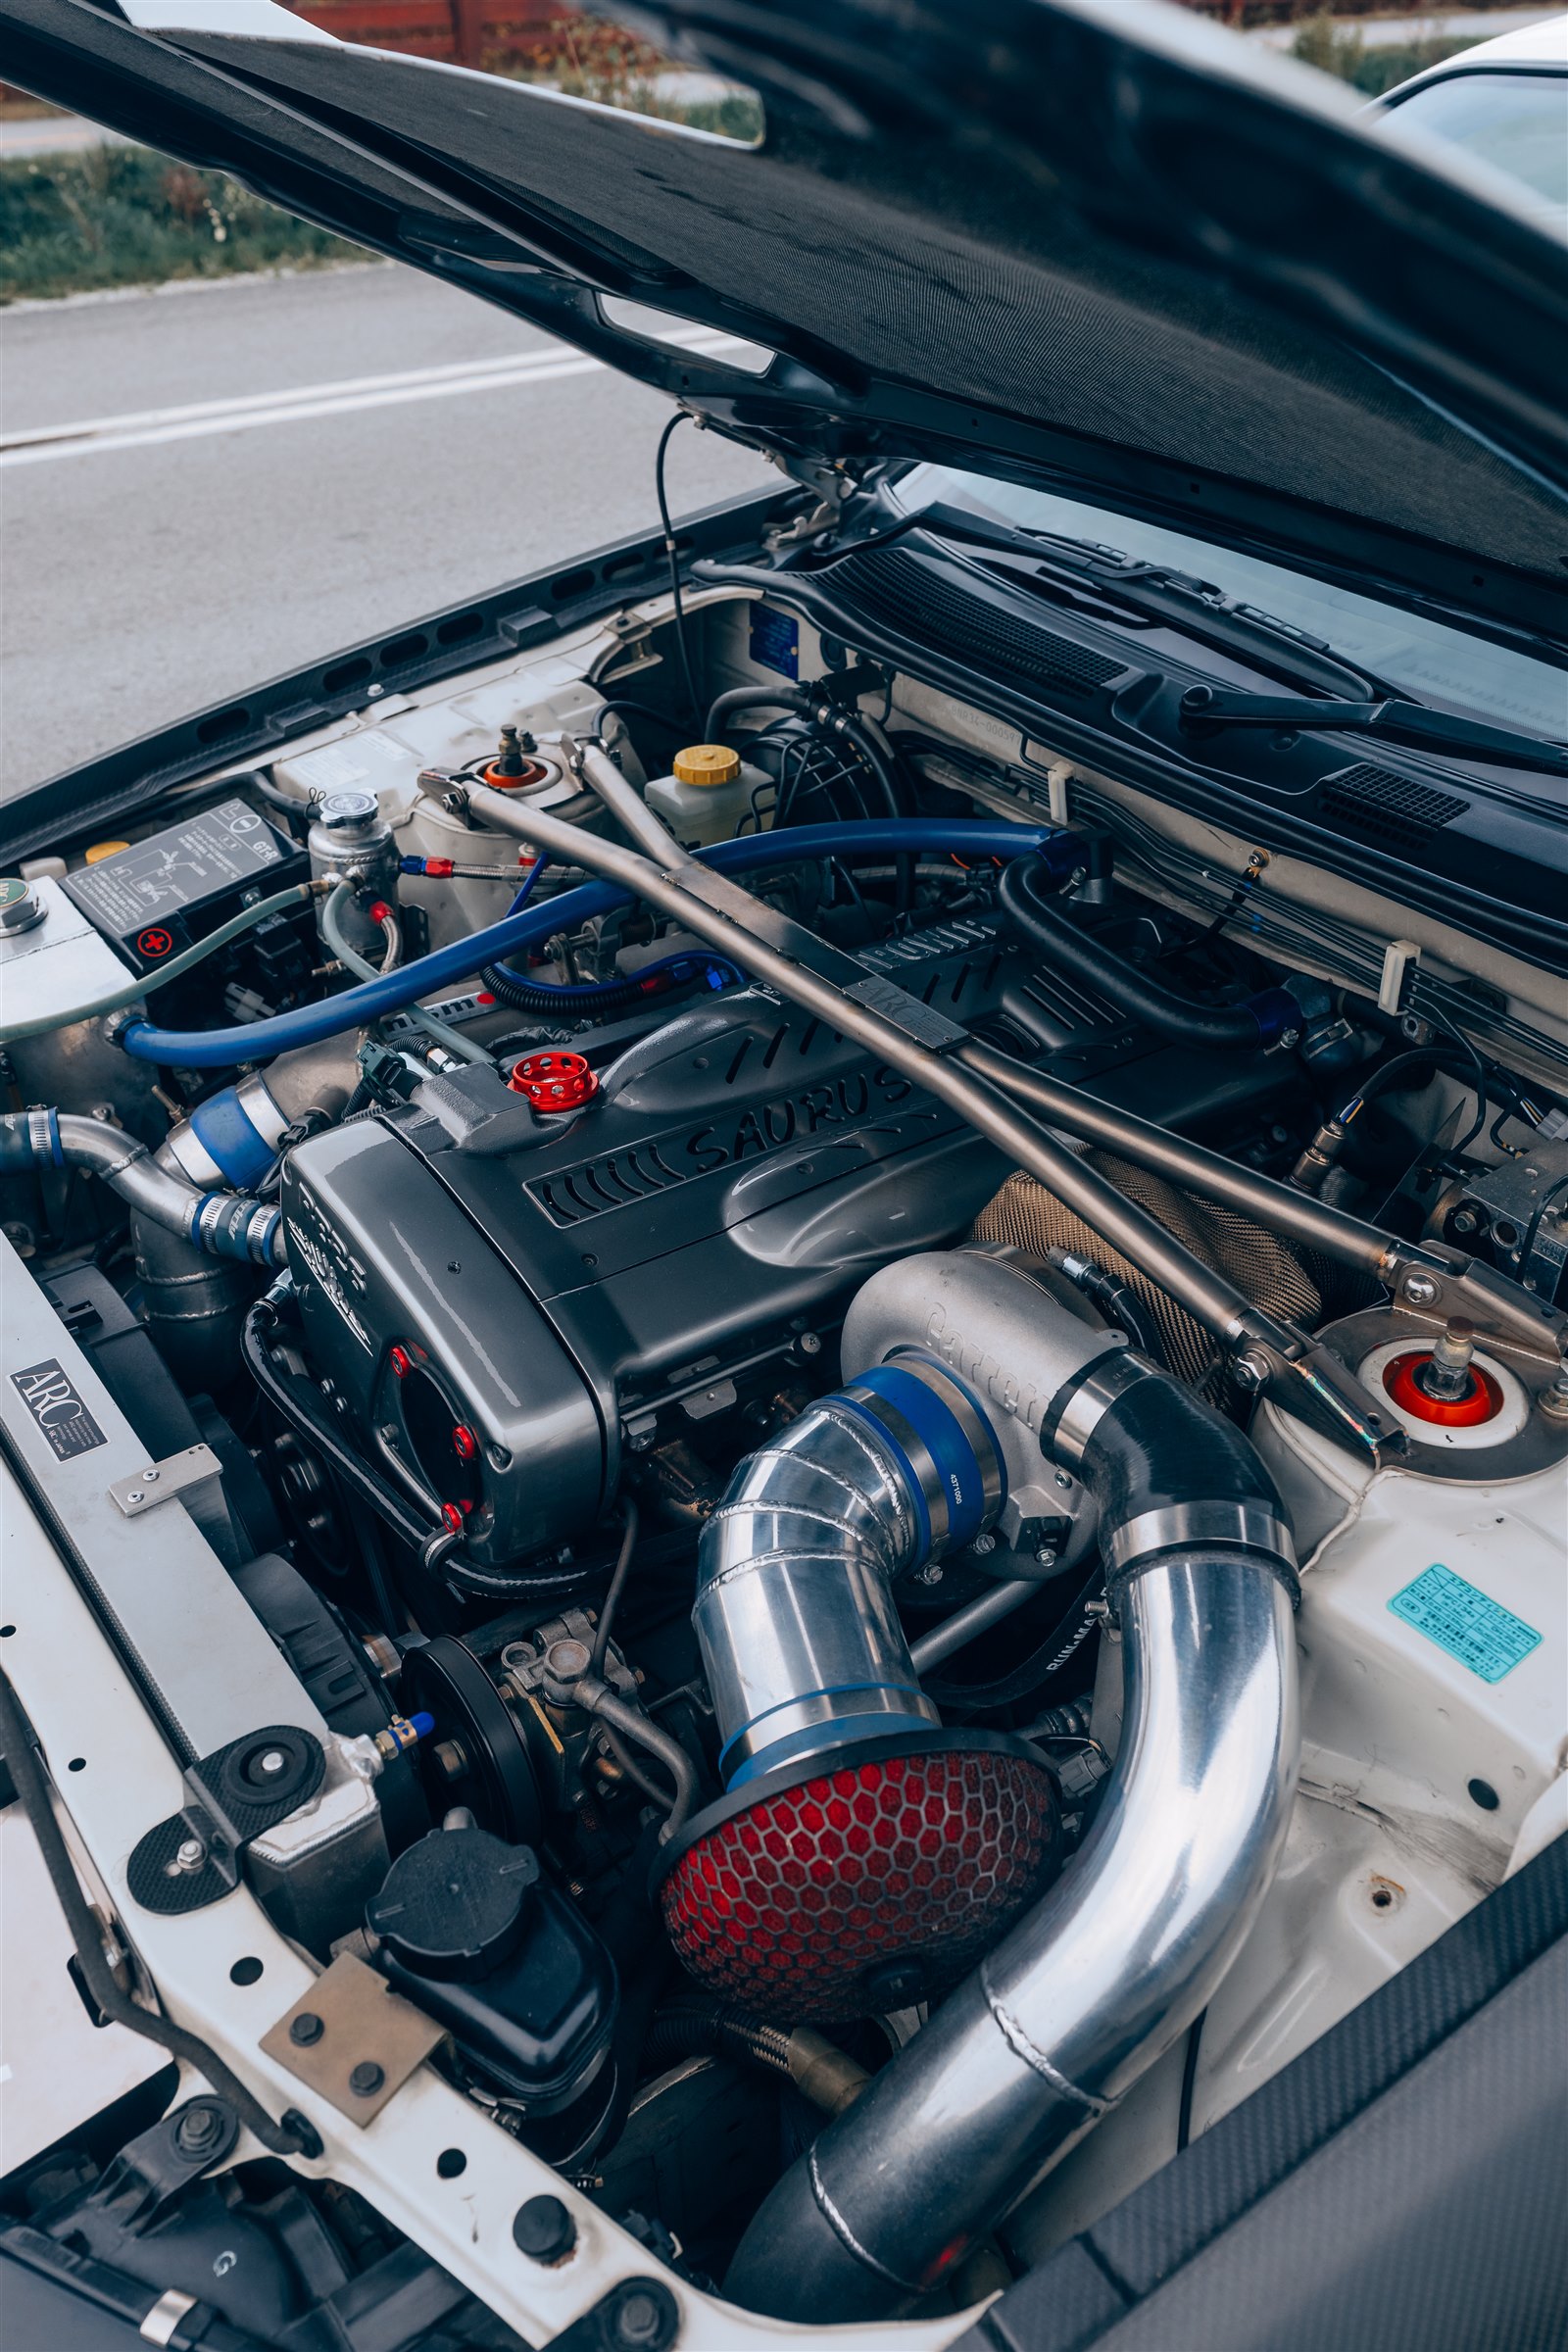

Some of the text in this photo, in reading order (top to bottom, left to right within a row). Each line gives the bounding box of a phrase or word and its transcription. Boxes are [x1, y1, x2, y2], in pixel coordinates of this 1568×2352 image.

[253, 838, 277, 861] GT-R
[384, 993, 496, 1032] nsmo
[862, 985, 928, 1025] ARC
[686, 1066, 912, 1172] SAURUS
[926, 1301, 1052, 1430] Garret
[16, 1370, 83, 1430] ARC
[949, 1472, 963, 1506] 4371000
